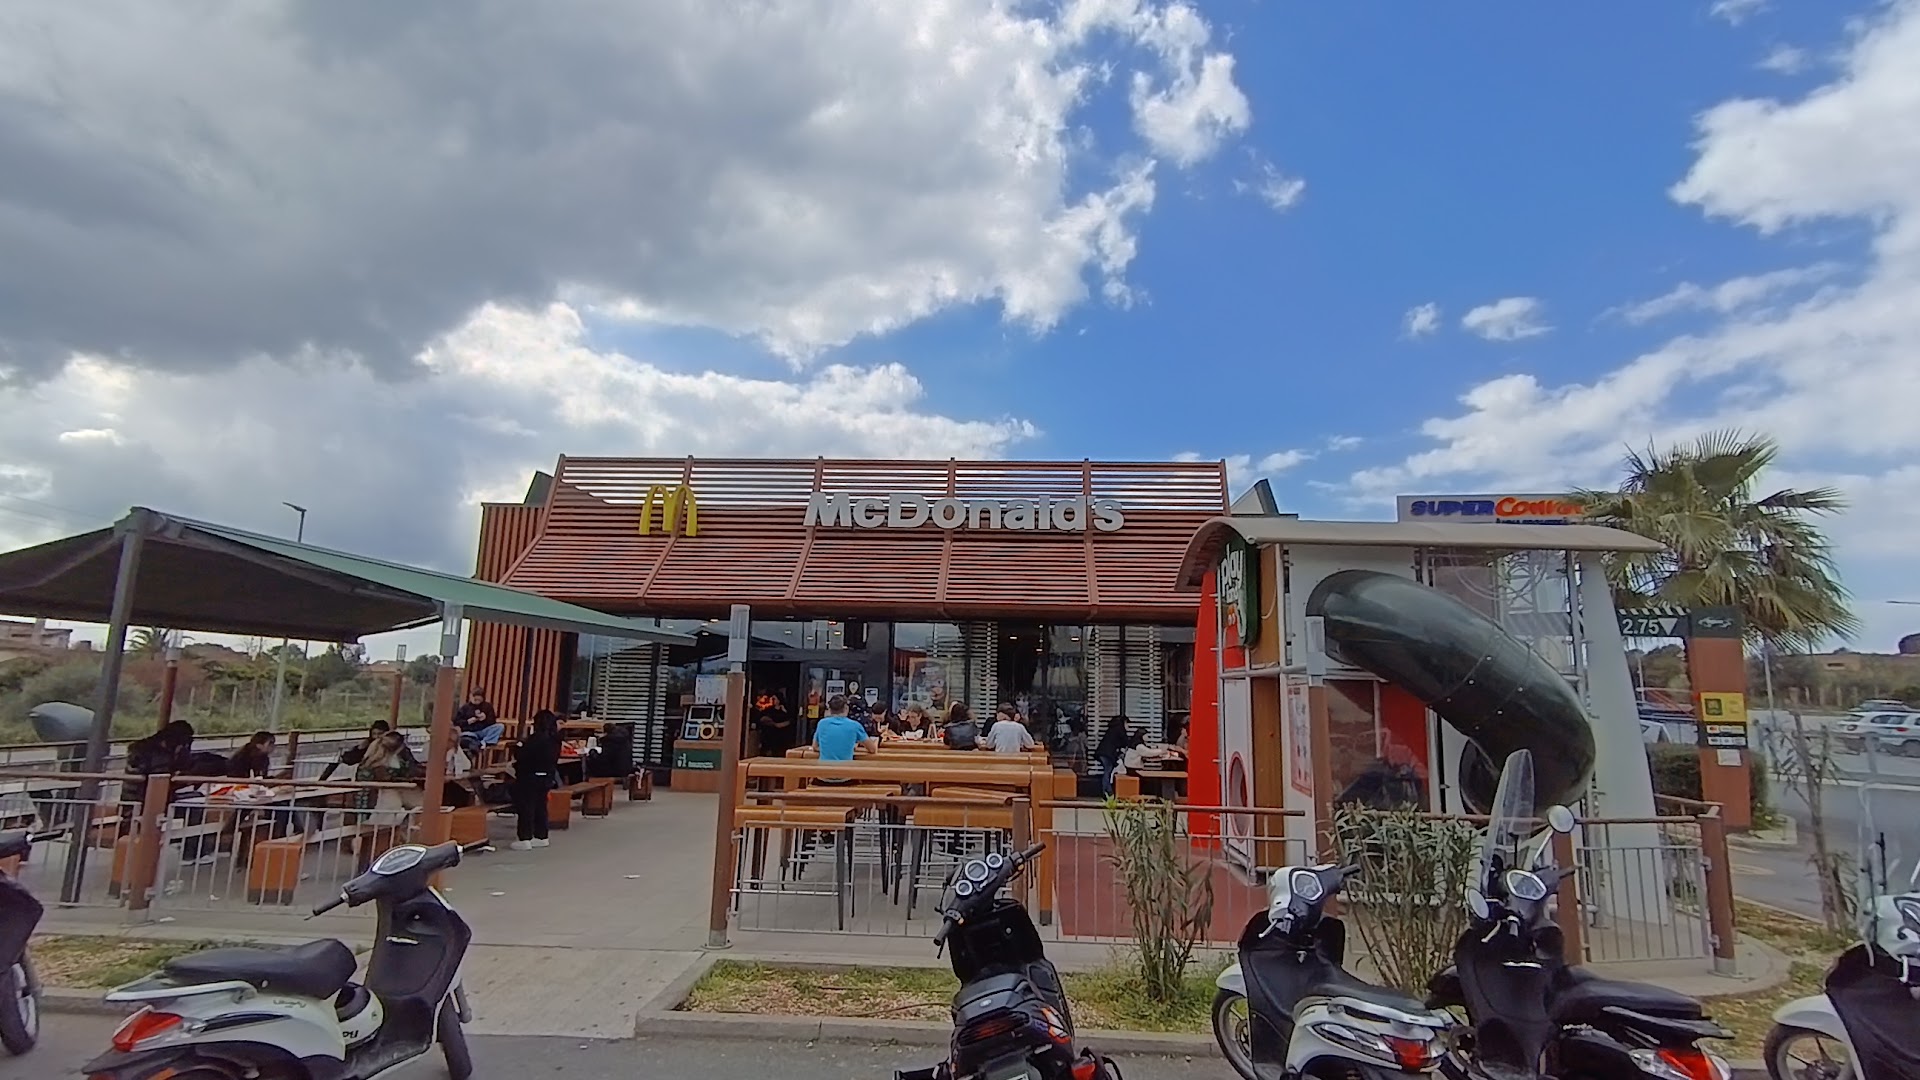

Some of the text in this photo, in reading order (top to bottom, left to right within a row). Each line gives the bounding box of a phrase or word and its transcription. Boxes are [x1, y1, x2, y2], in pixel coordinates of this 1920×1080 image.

[803, 491, 1125, 532] McDonald's
[1410, 500, 1495, 517] SUPER
[1621, 618, 1660, 635] 2.75
